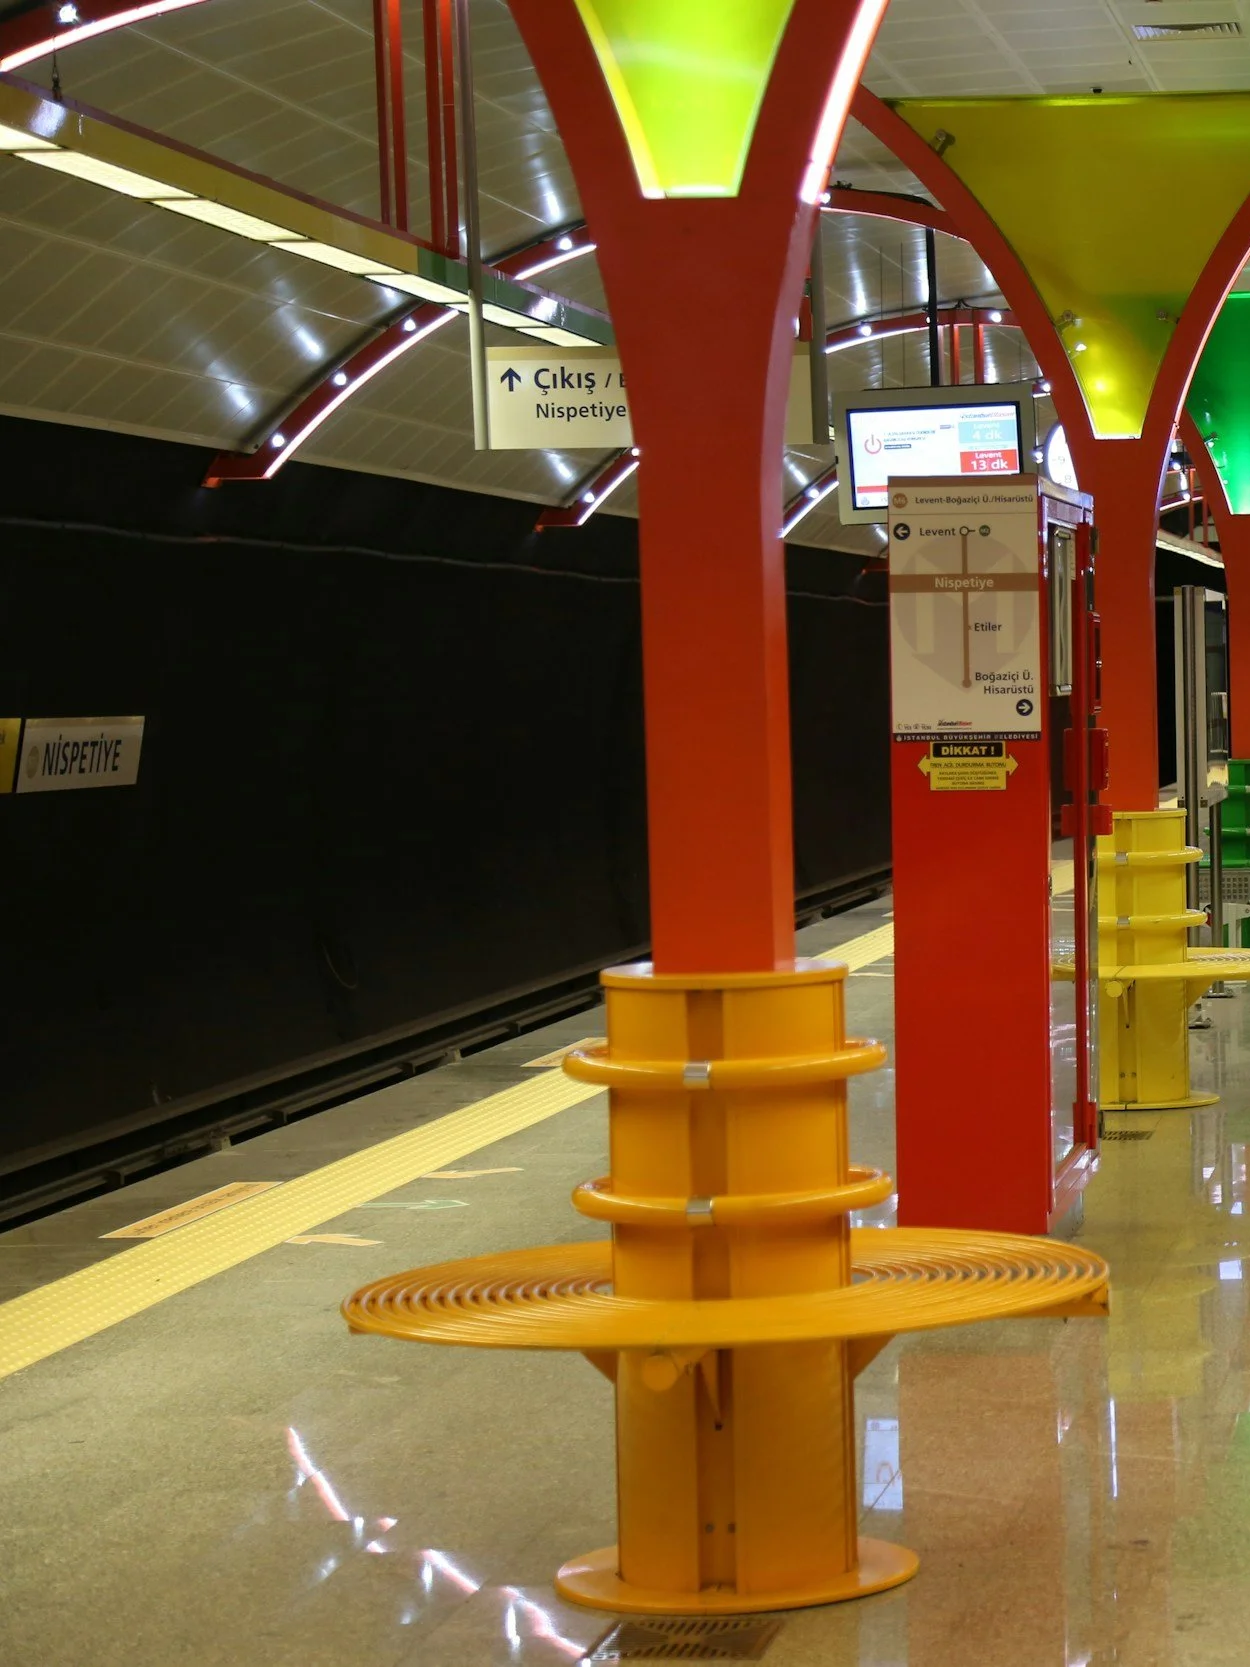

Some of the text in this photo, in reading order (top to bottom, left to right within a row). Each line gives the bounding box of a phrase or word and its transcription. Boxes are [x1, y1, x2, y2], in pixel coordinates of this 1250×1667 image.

[534, 366, 596, 395] Çıkış
[536, 402, 626, 421] Nispetiye
[972, 429, 1003, 439] 4 dk
[974, 451, 1003, 459] Levent
[971, 458, 1009, 470] 13 dk
[915, 495, 980, 505] Levent-Boğaziçi
[920, 527, 956, 537] Levent
[934, 576, 994, 590] Nispetiye
[974, 622, 1002, 632] Etiler
[975, 669, 1034, 683] Boğaziçi Ü.
[983, 684, 1034, 695] Hisarüstü
[42, 733, 122, 776] NİSPETİYE
[941, 744, 995, 756] DİKKAT !
